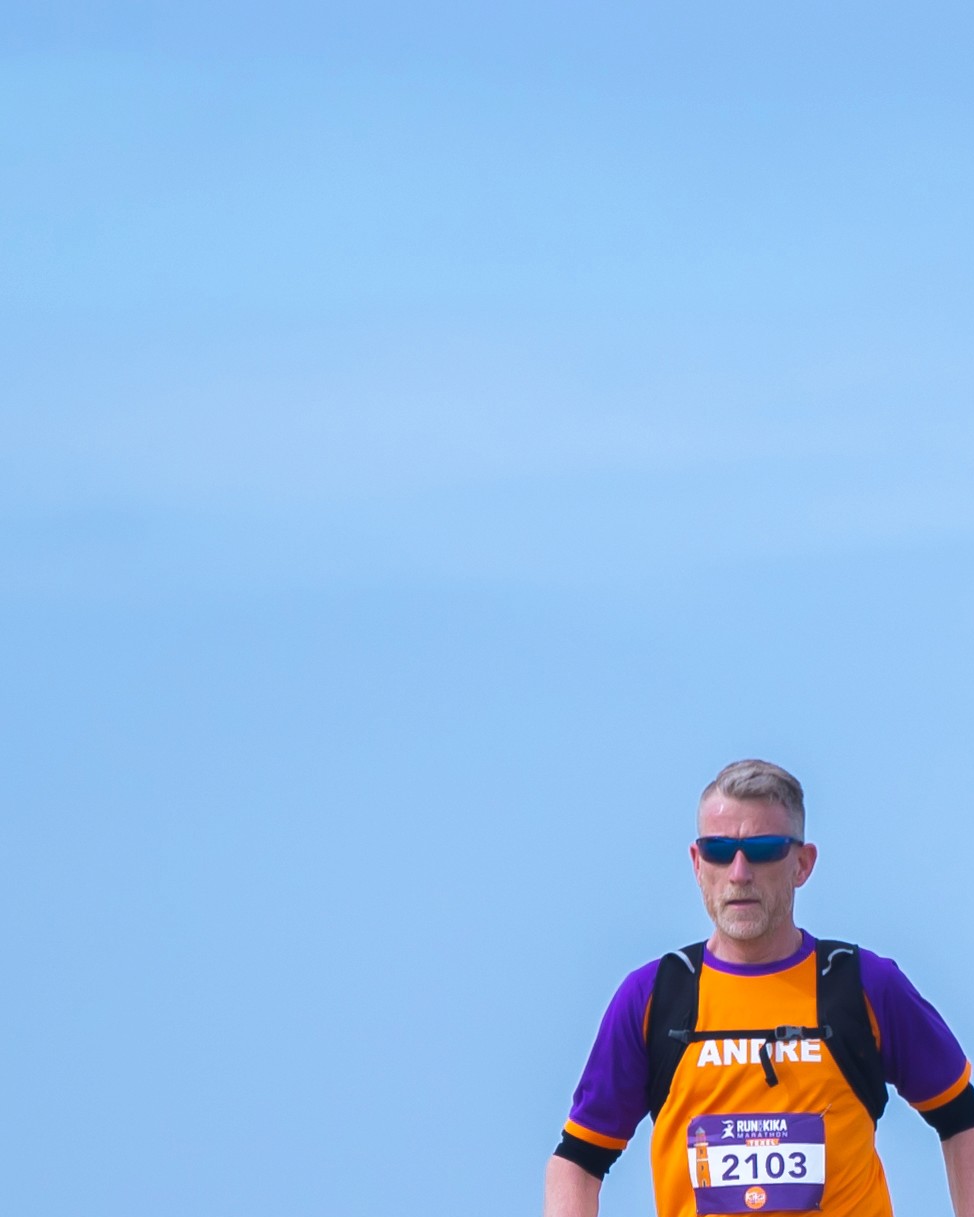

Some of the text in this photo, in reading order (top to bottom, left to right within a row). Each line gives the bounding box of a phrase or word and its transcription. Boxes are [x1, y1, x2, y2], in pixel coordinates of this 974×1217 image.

[697, 1038, 822, 1067] ANDRE
[737, 1120, 757, 1132] RUN
[763, 1119, 787, 1131] KIKA
[722, 1152, 807, 1180] 2103
